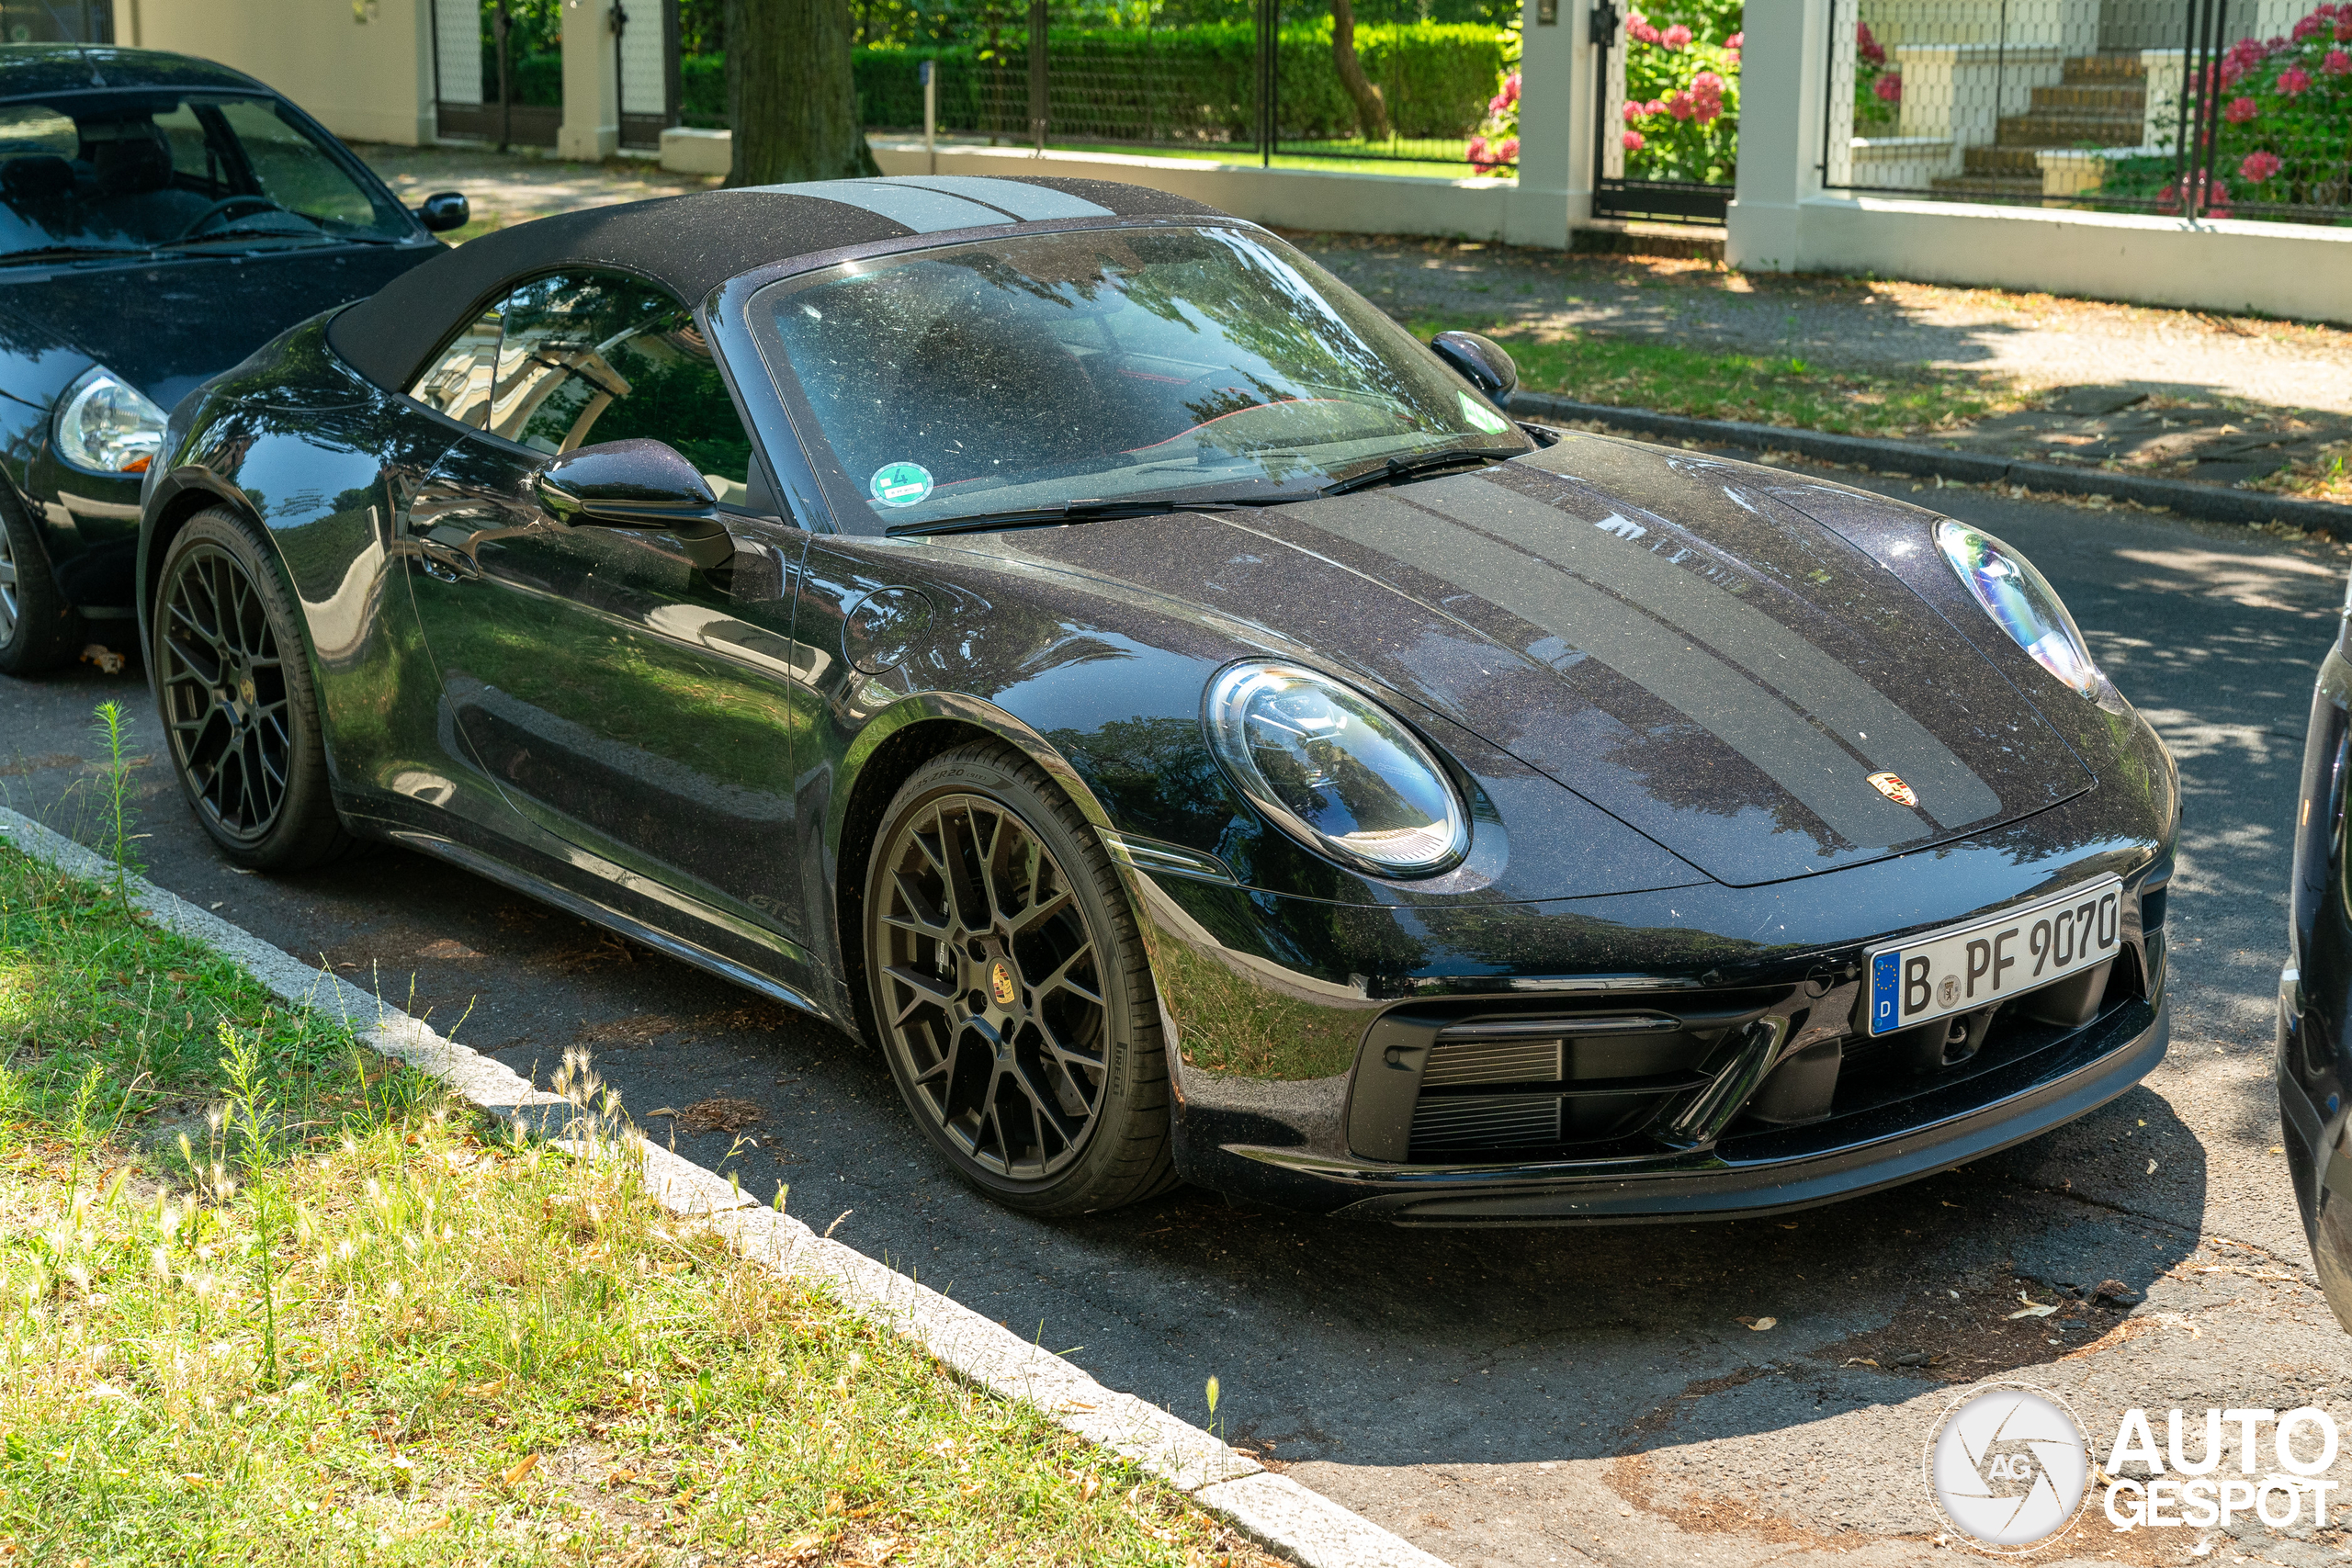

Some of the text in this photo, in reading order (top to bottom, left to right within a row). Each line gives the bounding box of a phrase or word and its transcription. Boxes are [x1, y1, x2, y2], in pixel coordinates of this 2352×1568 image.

[893, 468, 908, 484] 4
[930, 768, 966, 783] ZR20
[1904, 954, 1931, 1016] B
[1966, 927, 2018, 998] PF
[2030, 892, 2117, 977] 9070
[1880, 1000, 1891, 1018] D
[1113, 1041, 1128, 1098] PIRELLI
